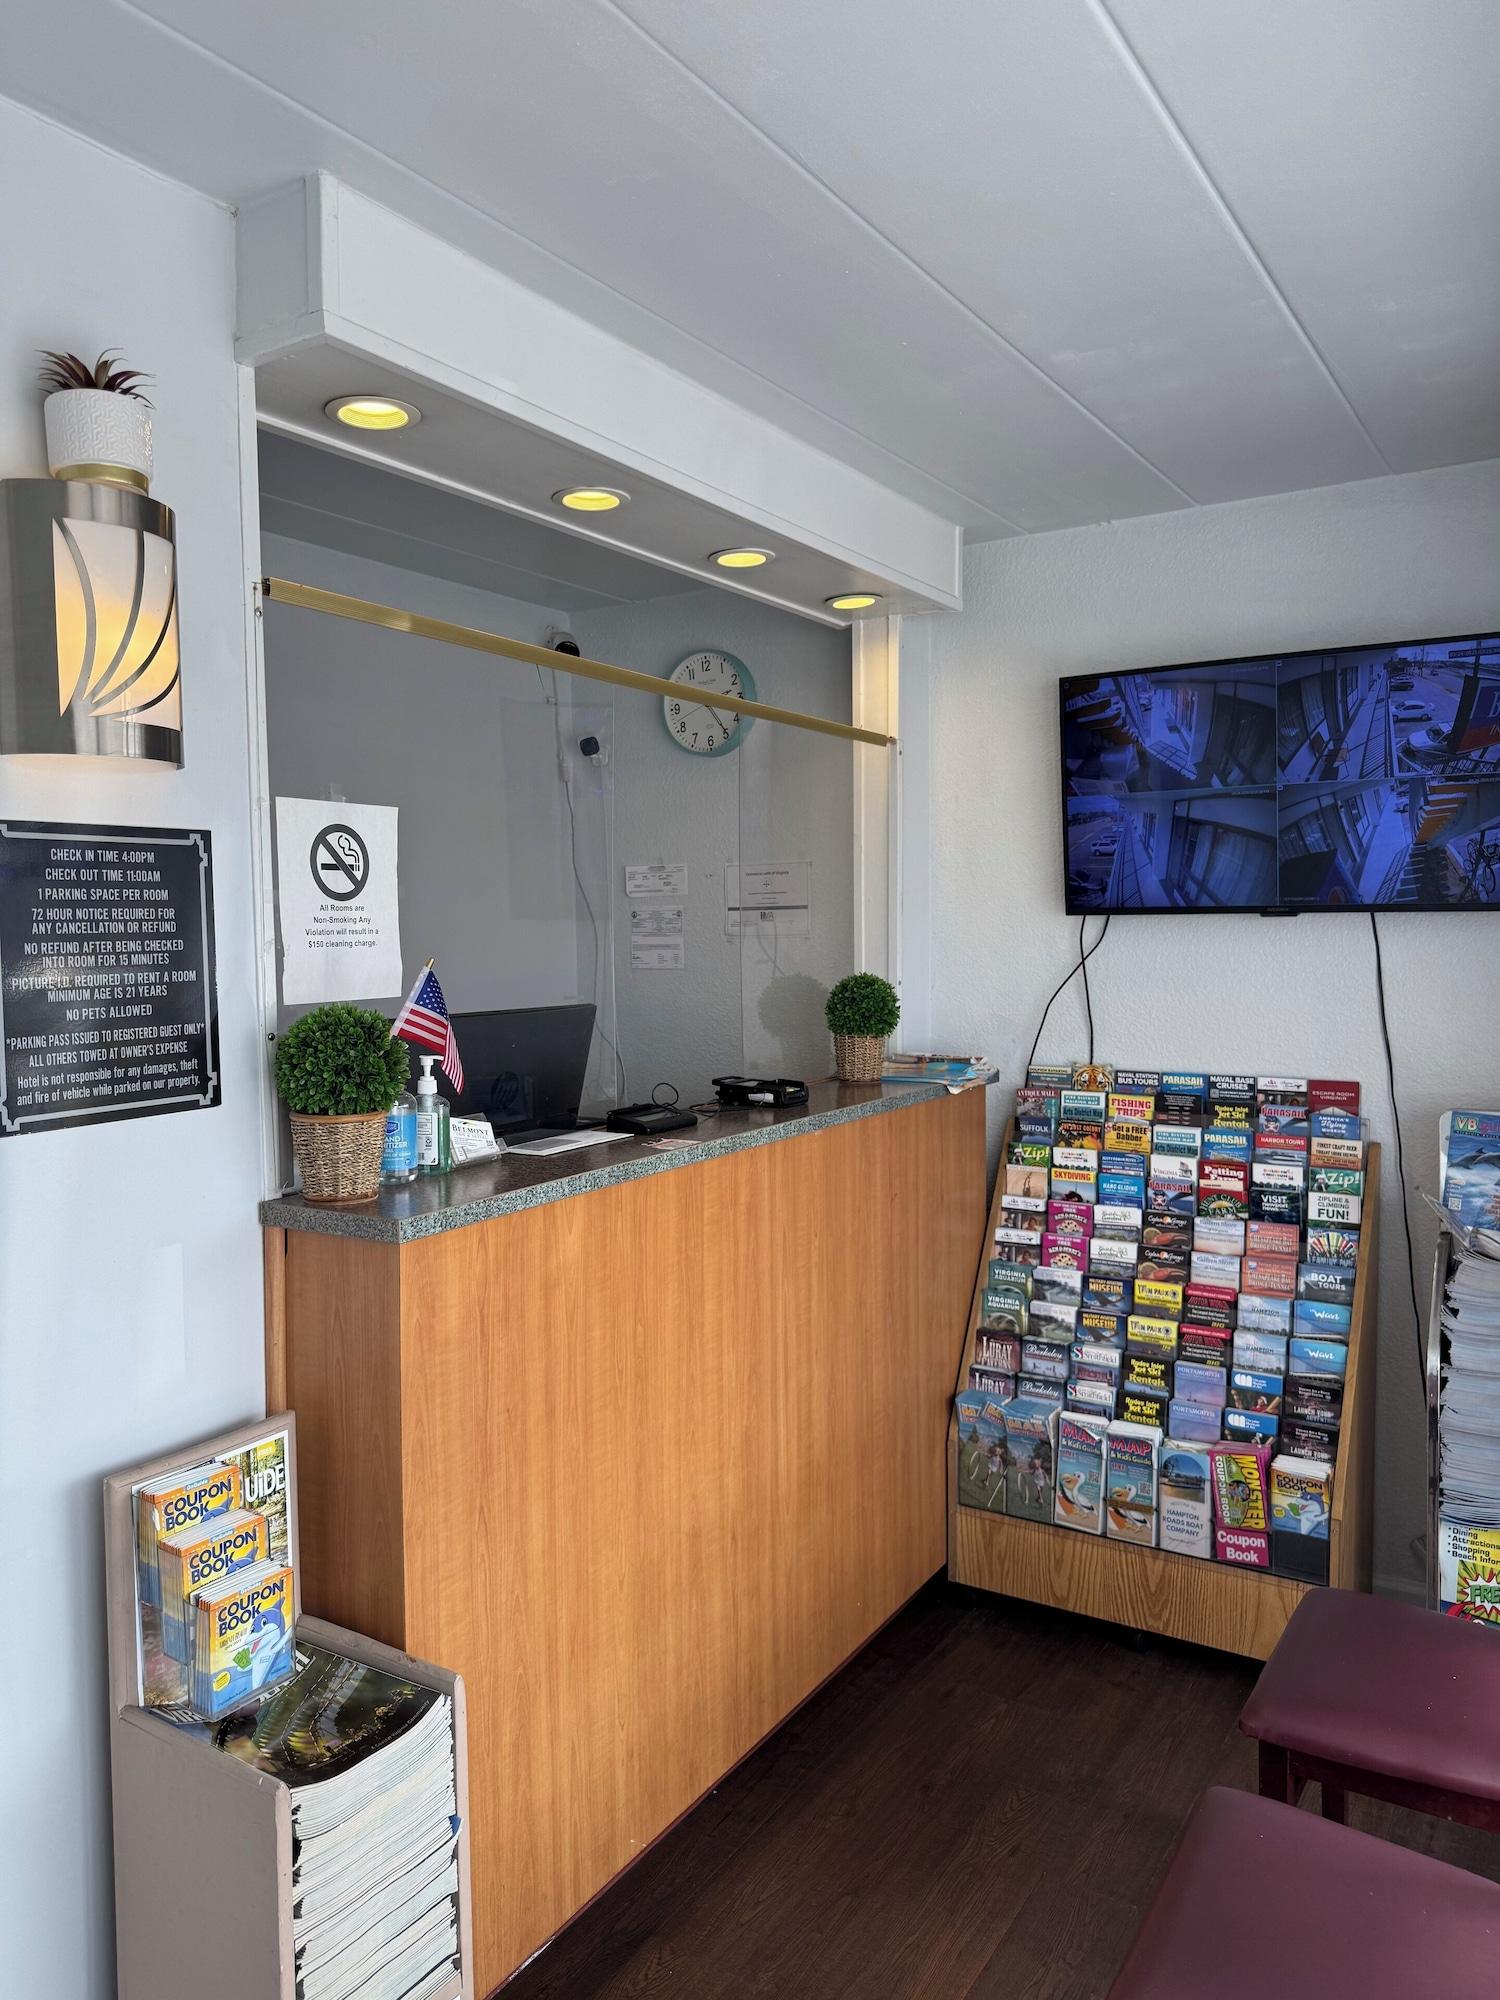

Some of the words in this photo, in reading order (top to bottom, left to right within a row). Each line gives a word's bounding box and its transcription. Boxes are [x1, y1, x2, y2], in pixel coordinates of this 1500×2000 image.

[701, 660, 711, 672] 12
[689, 669, 695, 680] 11
[731, 674, 738, 685] 2
[674, 704, 680, 715] 9
[733, 713, 740, 724] 4
[680, 722, 686, 733] 8
[723, 728, 729, 740] 5
[692, 733, 698, 744] 7
[708, 736, 714, 747] 6
[51, 848, 82, 861] CHECK
[85, 849, 94, 861] IN
[97, 850, 119, 862] TIME
[122, 851, 155, 863] 4:00PM
[45, 868, 77, 881] CHECK
[80, 869, 99, 881] OUT
[102, 870, 124, 882] TIME
[126, 871, 161, 882] 11:00AM
[38, 888, 43, 900] 1
[45, 888, 87, 901] PARKING
[91, 889, 120, 901] SPACE
[123, 889, 141, 901] PER
[143, 889, 169, 901] ROOM
[32, 908, 43, 920] 72
[47, 908, 73, 920] HOUR
[76, 908, 109, 920] NOTICE
[112, 908, 155, 920] REQUIRED
[158, 909, 175, 920] FOR
[313, 916, 357, 925] Non-Smoking
[358, 916, 371, 924] Any
[32, 922, 52, 934] ANY
[56, 922, 125, 934] CANCELLATION
[127, 922, 139, 933] OR
[142, 921, 177, 933] REFUND
[305, 928, 335, 936] Violation
[24, 943, 38, 955] NO
[41, 942, 79, 954] REFUND
[83, 941, 112, 953] AFTER
[116, 941, 142, 952] BEING
[144, 940, 184, 951] CHECKED
[308, 940, 324, 949] $150
[325, 940, 353, 949] cleaning
[354, 939, 378, 948] charge.
[43, 956, 65, 968] INTO
[68, 955, 96, 967] ROOM
[98, 955, 116, 966] FOR
[120, 954, 130, 966] 15
[132, 953, 169, 965] MINUTES
[12, 976, 55, 991] PICTURE
[75, 974, 121, 988] REQUIRED
[125, 973, 135, 985] TO
[138, 972, 161, 984] RENT
[164, 971, 169, 982] A
[172, 970, 197, 982] ROOM
[48, 989, 91, 1003] MINIMUM
[94, 988, 111, 1000] AGE
[115, 987, 123, 999] IS
[126, 987, 135, 998] 21
[138, 985, 168, 997] YEARS
[67, 1009, 79, 1021] NO
[82, 1007, 106, 1020] PETS
[110, 1004, 153, 1018] ALLOWED
[49, 1033, 69, 1047] PASS
[72, 1031, 99, 1045] ISSUED
[102, 1030, 111, 1042] TO
[114, 1027, 158, 1041] REGISTERED
[160, 1025, 182, 1036] GUEST
[29, 1055, 44, 1068] ALL
[47, 1051, 77, 1066] OTHERS
[80, 1049, 107, 1063] TOWED
[109, 1047, 118, 1059] AT
[121, 1044, 154, 1059] OWNER'S
[156, 1042, 188, 1055] EXPENSE
[18, 1075, 39, 1089] Hotel
[42, 1074, 49, 1086] is
[51, 1073, 64, 1085] not
[67, 1068, 112, 1084] responsible
[114, 1066, 125, 1078] for
[127, 1066, 142, 1078] any
[143, 1063, 179, 1075] damages,
[180, 1058, 198, 1071] theft
[1117, 1071, 1136, 1079] NAVAL
[1162, 1075, 1204, 1086] PARASAIL
[1216, 1082, 1249, 1090] CRUISES
[1235, 1077, 1255, 1085] BASE
[17, 1093, 32, 1106] and
[35, 1090, 49, 1104] fire
[52, 1089, 60, 1102] of
[63, 1085, 91, 1100] vehicle
[93, 1083, 113, 1097] while
[114, 1081, 141, 1096] parked
[142, 1081, 152, 1090] on
[154, 1080, 166, 1089] our
[168, 1074, 201, 1089] property.
[1111, 1098, 1151, 1109] FISHING
[1115, 1107, 1147, 1118] TRIPS
[452, 1124, 488, 1136] BELMONT
[1020, 1124, 1049, 1133] SUFFOLK
[1112, 1124, 1125, 1132] Get
[1131, 1126, 1148, 1135] FREE
[1116, 1132, 1143, 1142] Dabber
[1023, 1147, 1049, 1161] Zip!
[1054, 1170, 1091, 1181] SKYDIVING
[1204, 1166, 1244, 1179] Petting
[1261, 1194, 1288, 1204] VISIT
[1317, 1209, 1350, 1221] FUN!
[994, 1268, 1026, 1278] VIRGINIA
[1311, 1273, 1342, 1284] BOAT
[1318, 1282, 1346, 1291] TOURS
[1082, 1316, 1117, 1330] MUSEUM
[1215, 1455, 1227, 1496] COUPON
[1276, 1474, 1323, 1491] COUPON
[1277, 1482, 1308, 1493] BOOK
[163, 1477, 232, 1517] COUPON
[1231, 1455, 1265, 1530] MONSTER
[1166, 1509, 1200, 1522] HAMPTON
[1220, 1495, 1231, 1524] BOOK
[165, 1501, 210, 1532] BOOK
[1162, 1516, 1184, 1527] ROADS
[1185, 1520, 1204, 1530] BOAT
[1166, 1524, 1200, 1537] COMPANY
[1453, 1527, 1478, 1540] Dining
[1217, 1531, 1266, 1548] Coupon
[189, 1527, 257, 1570] COUPON
[1226, 1547, 1259, 1563] Book
[1452, 1543, 1490, 1558] Shopping
[1452, 1550, 1477, 1561] Beach
[190, 1551, 235, 1585] BOOK
[217, 1578, 285, 1623] COUPON
[219, 1603, 262, 1638] BOOK
